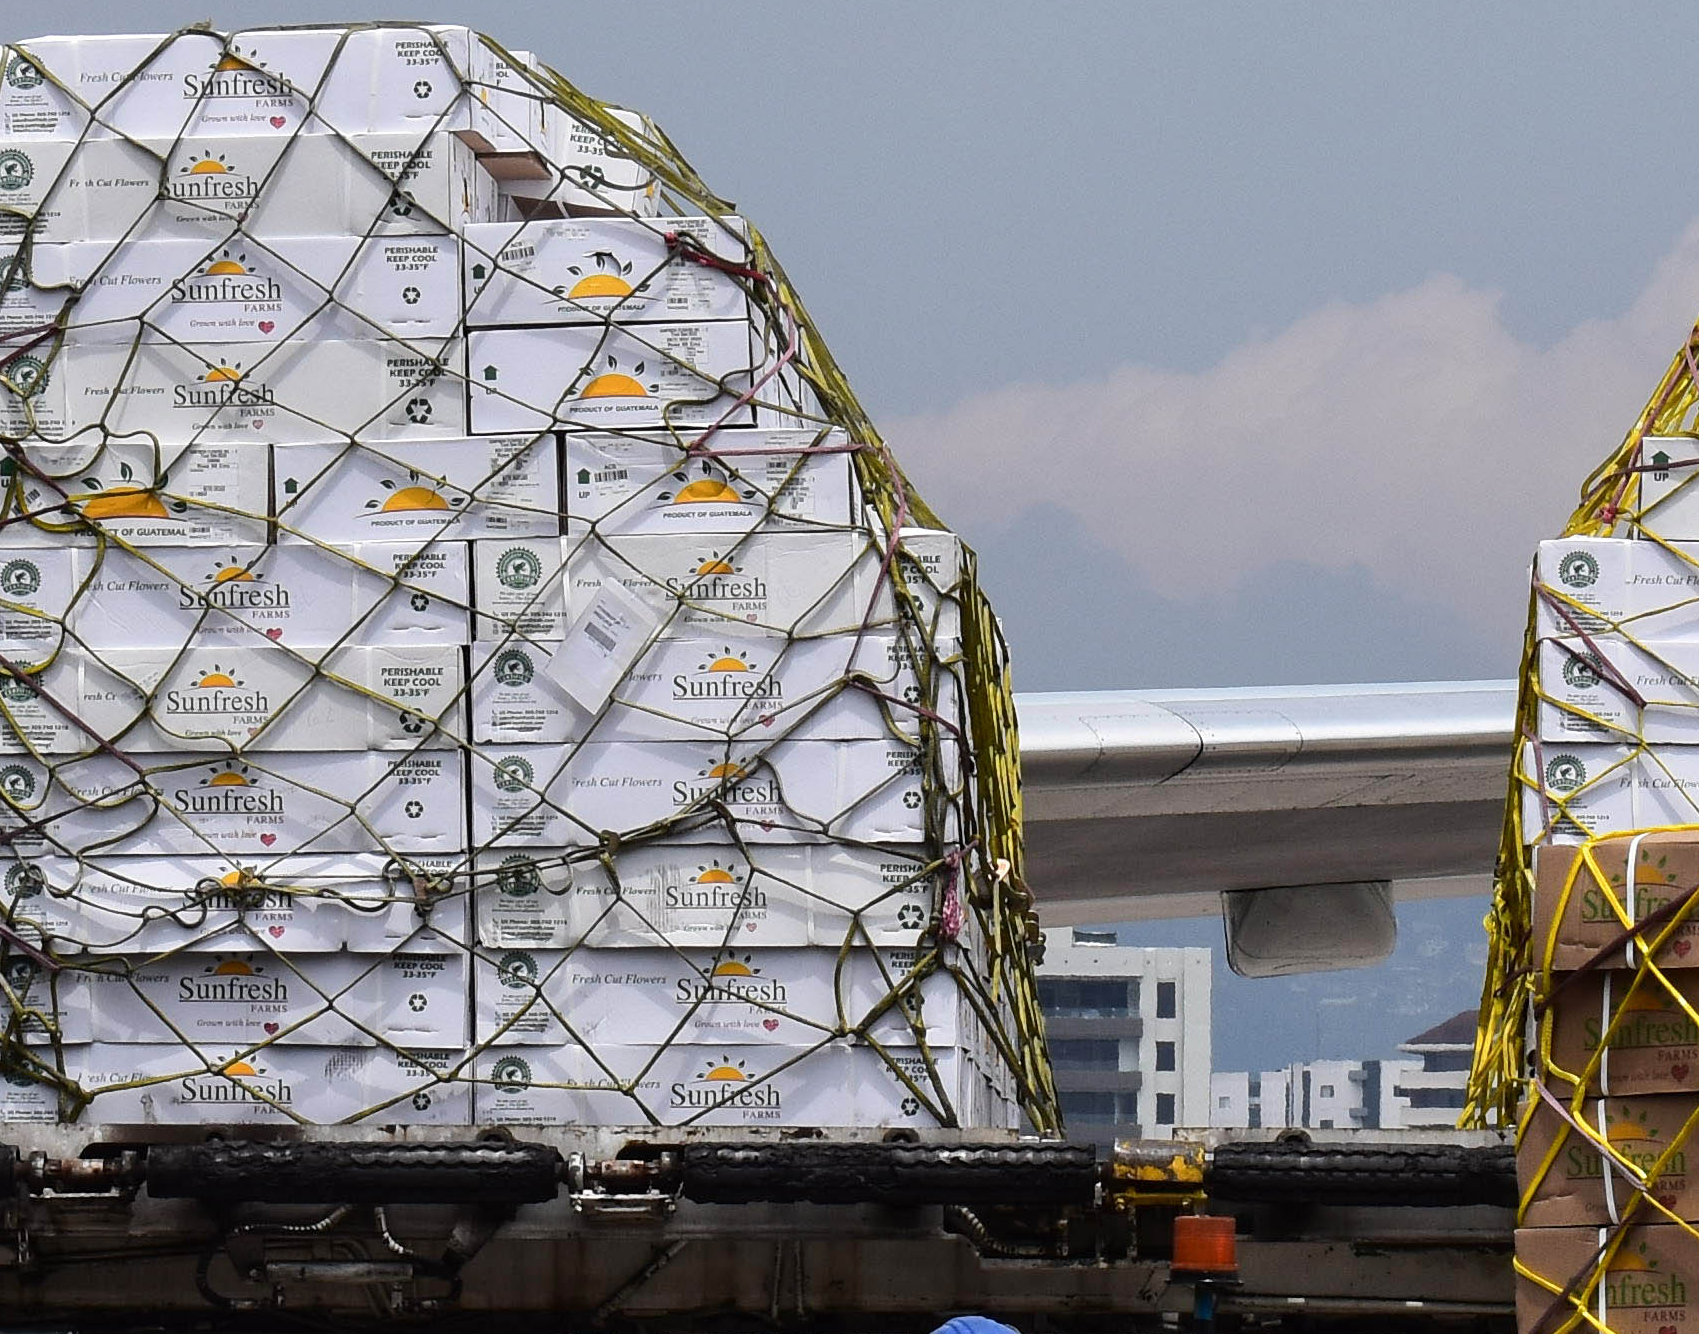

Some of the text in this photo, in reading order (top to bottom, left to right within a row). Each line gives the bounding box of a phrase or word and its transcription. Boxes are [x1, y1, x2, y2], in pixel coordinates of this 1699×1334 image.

[183, 73, 292, 96] Sunfresh
[255, 98, 293, 107] FARMS
[120, 275, 161, 285] Flowers
[172, 278, 281, 300] Sunfresh
[244, 304, 282, 312] FARMS
[219, 319, 235, 327] with
[240, 408, 275, 416] FARMS
[615, 404, 659, 412] GUATEMALA
[1654, 473, 1669, 482] UP
[663, 510, 753, 519] PRODUCT GUATEMALA
[122, 527, 187, 536] OF GUATEMAL
[1633, 576, 1683, 585] Fresh Cut
[128, 581, 169, 591] Flowers
[252, 610, 290, 618] FARMS
[381, 668, 443, 677] PERISHABLE
[384, 678, 441, 686] KEEP COOL
[673, 675, 782, 697] Sunfresh
[167, 691, 268, 712] Sunfresh
[621, 777, 662, 787] Flowers
[174, 790, 283, 812] Sunfresh
[247, 815, 284, 824] FARMS
[255, 912, 293, 921] FARMS
[572, 974, 666, 984] Fresh Cut Flowers
[179, 977, 288, 1000] Sunfresh
[251, 1004, 288, 1012] FARMS
[743, 1110, 781, 1118] FARMS
[1644, 1310, 1686, 1322] FARMS
